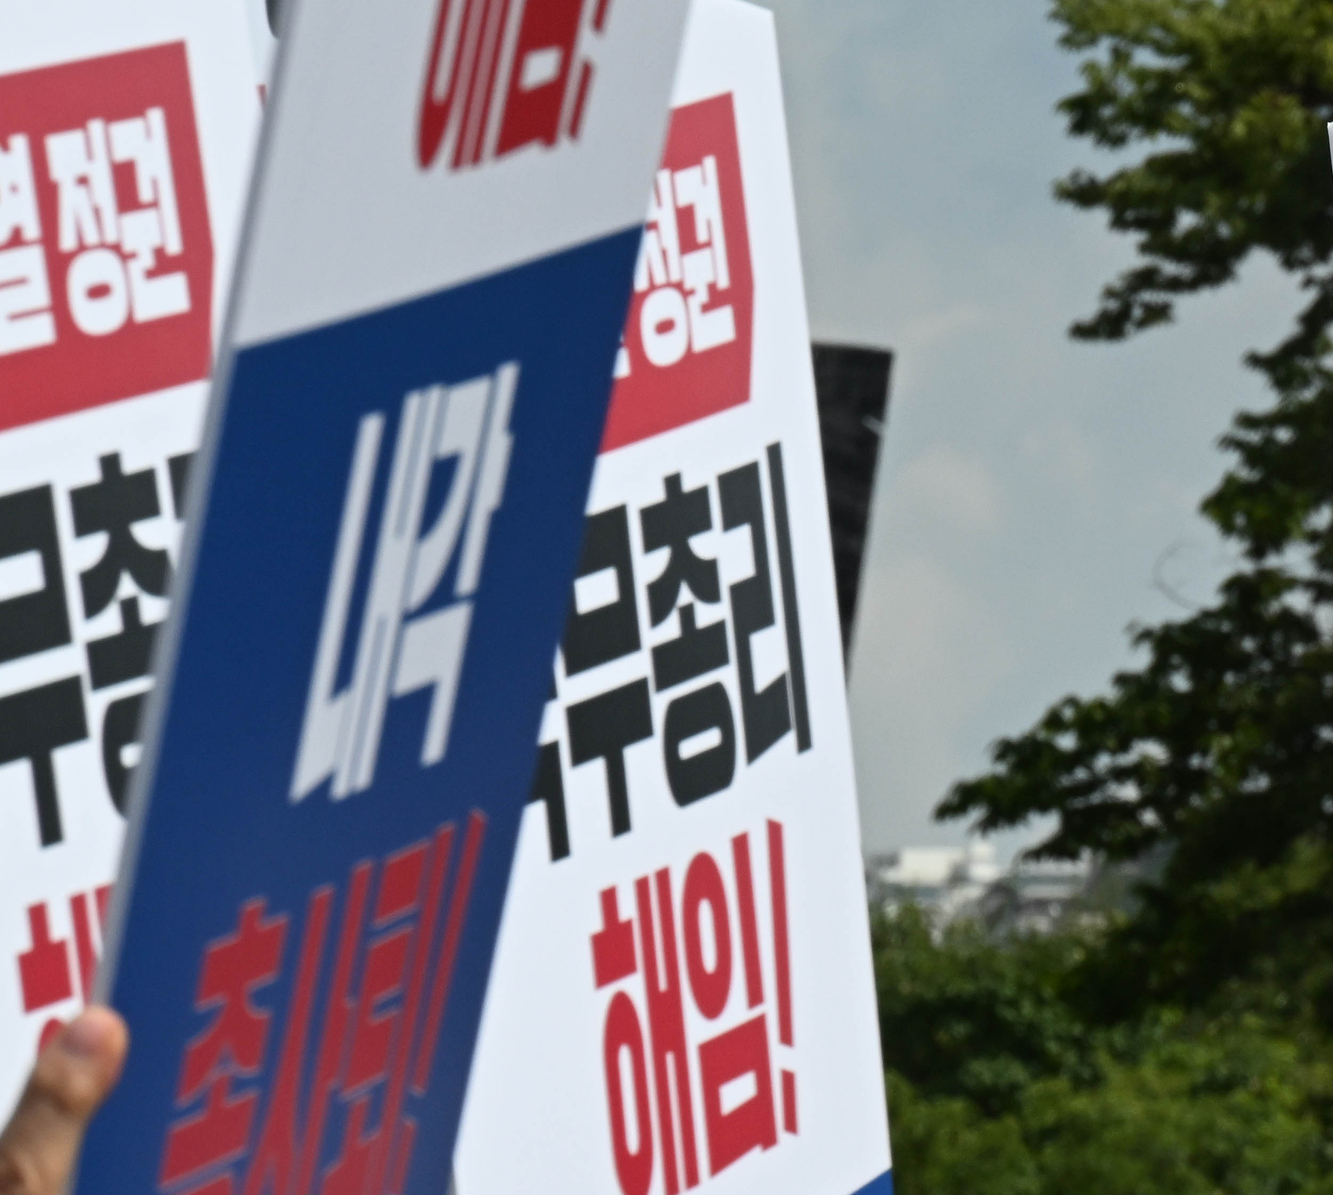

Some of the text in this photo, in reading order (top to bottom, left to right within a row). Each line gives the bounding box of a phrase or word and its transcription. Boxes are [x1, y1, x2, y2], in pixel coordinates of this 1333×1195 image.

[46, 107, 191, 337] 정권
[288, 362, 520, 805] 내각
[528, 440, 813, 864] 무총리
